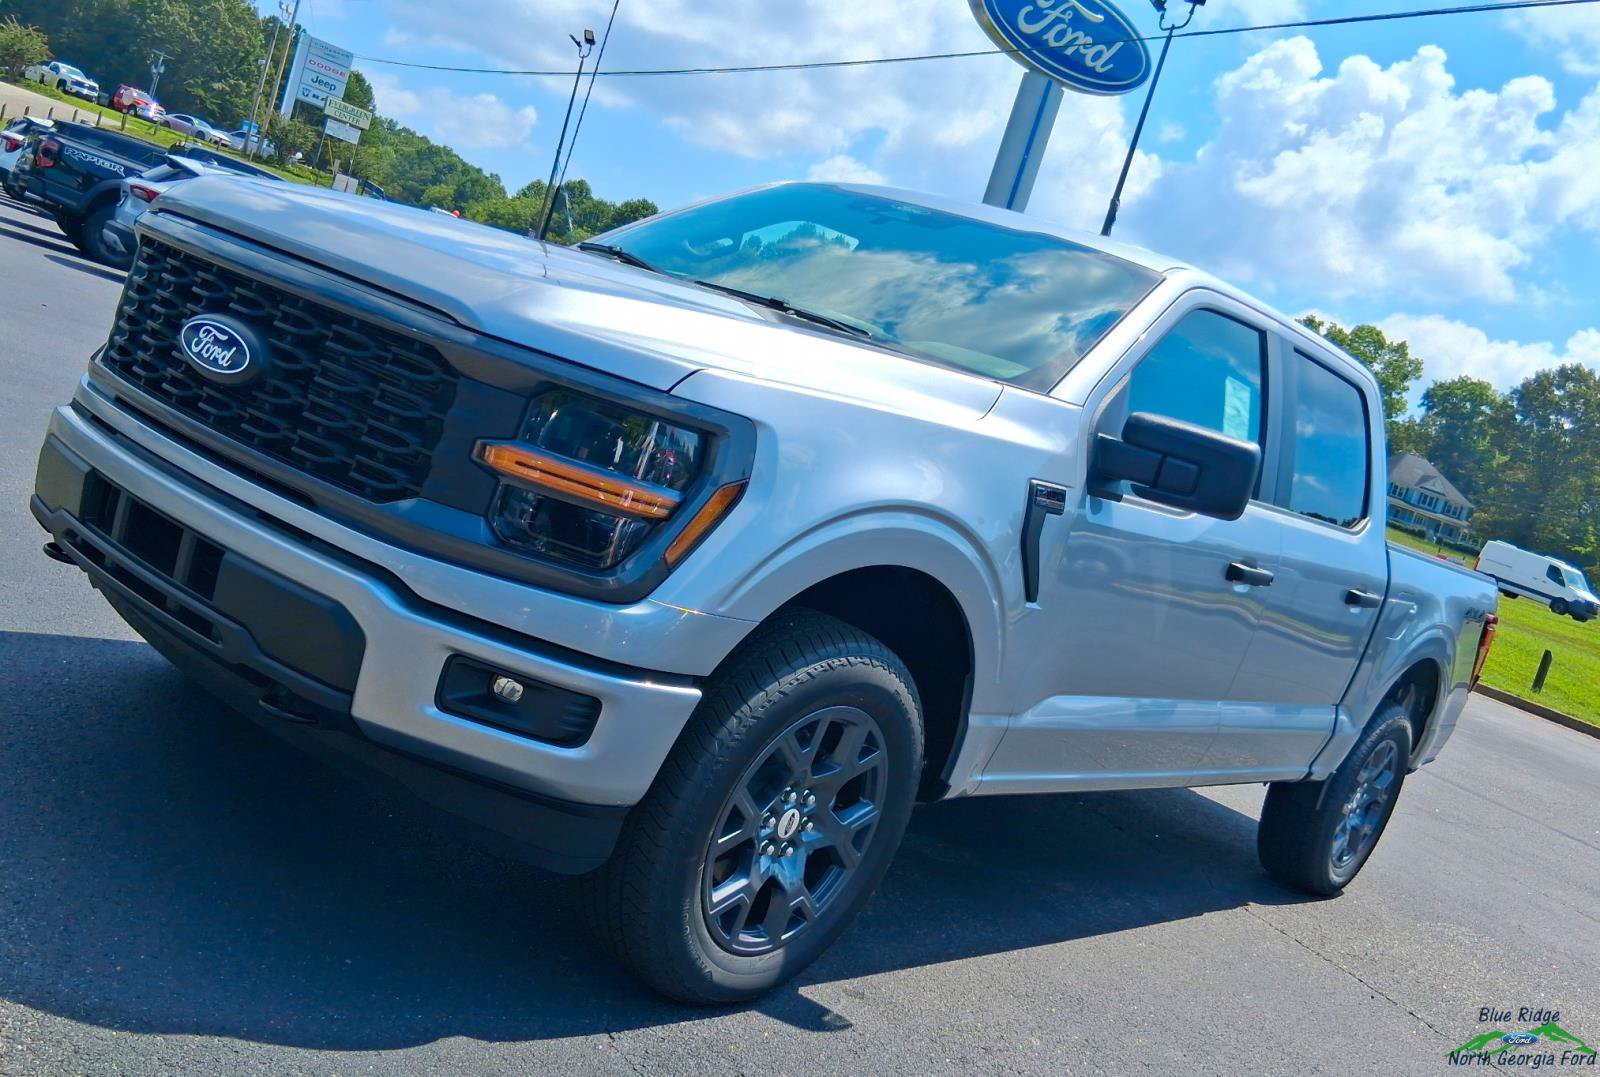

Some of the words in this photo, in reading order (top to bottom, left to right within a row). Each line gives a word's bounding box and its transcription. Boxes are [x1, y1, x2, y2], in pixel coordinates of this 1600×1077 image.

[1017, 0, 1126, 73] Ford
[308, 59, 346, 77] DODGE
[311, 75, 337, 91] Jeep
[334, 109, 361, 125] CENTER
[64, 146, 125, 177] RAPTOR
[191, 325, 237, 367] Ford
